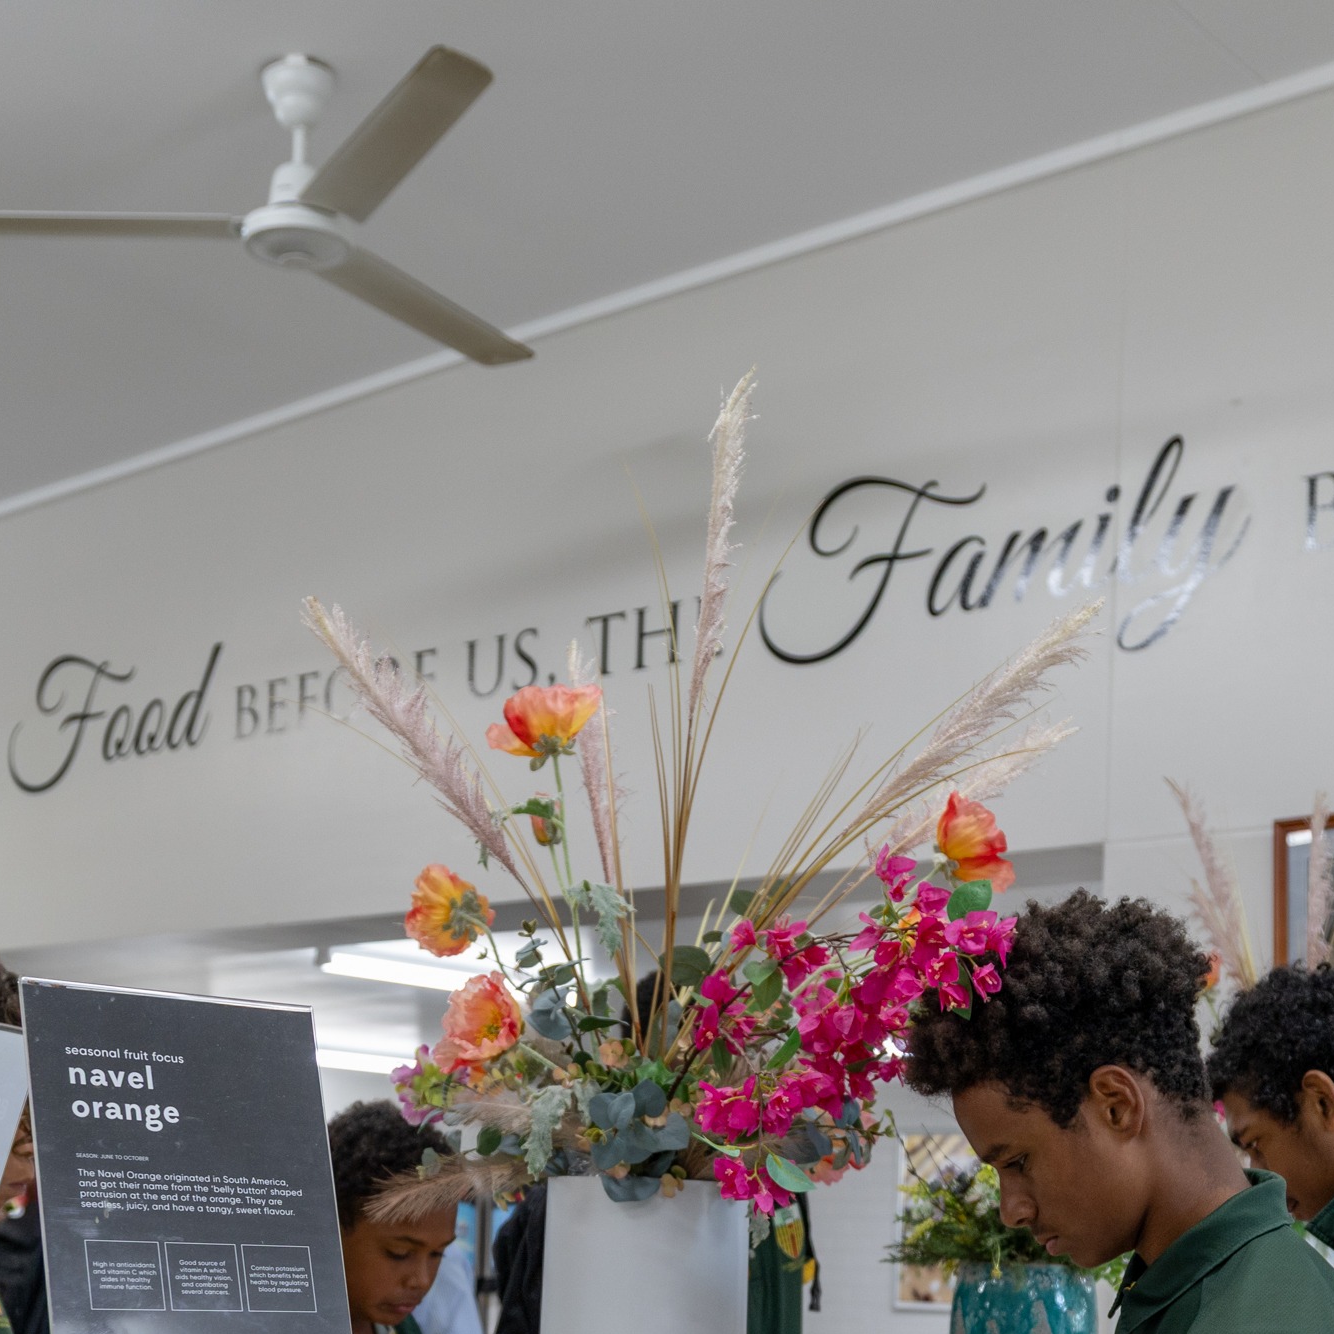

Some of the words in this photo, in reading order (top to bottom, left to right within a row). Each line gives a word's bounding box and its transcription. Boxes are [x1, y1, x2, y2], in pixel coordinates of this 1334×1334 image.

[7, 641, 225, 795] Food
[465, 626, 556, 697] US,
[586, 595, 723, 676] TH
[756, 434, 1252, 664] Family
[65, 1046, 121, 1059] seasonal
[124, 1049, 149, 1061] fruit
[152, 1051, 184, 1064] focus
[68, 1064, 154, 1090] navel
[71, 1099, 180, 1132] orange
[77, 1168, 95, 1177] The
[97, 1169, 124, 1179] Navel
[127, 1171, 161, 1182] Orange
[164, 1173, 210, 1183] originated
[212, 1175, 220, 1183] in
[223, 1175, 249, 1184] South
[251, 1177, 289, 1187] America,
[79, 1180, 97, 1188] and
[100, 1181, 117, 1189] got
[119, 1181, 140, 1189] their
[143, 1183, 168, 1191] name
[171, 1183, 191, 1191] from
[194, 1184, 209, 1193] the
[270, 1188, 302, 1197] shaped
[80, 1190, 127, 1199] protrusion
[180, 1194, 190, 1202] of
[192, 1194, 207, 1202] the
[209, 1196, 243, 1205] orange.
[245, 1196, 266, 1206] They
[81, 1201, 124, 1210] seedless,
[126, 1201, 150, 1211] juicy,
[152, 1203, 170, 1211] and
[172, 1203, 194, 1212] have
[206, 1205, 234, 1215] tangy,
[236, 1207, 262, 1215] sweet
[264, 1207, 295, 1216] flavour.
[92, 1261, 108, 1269] High
